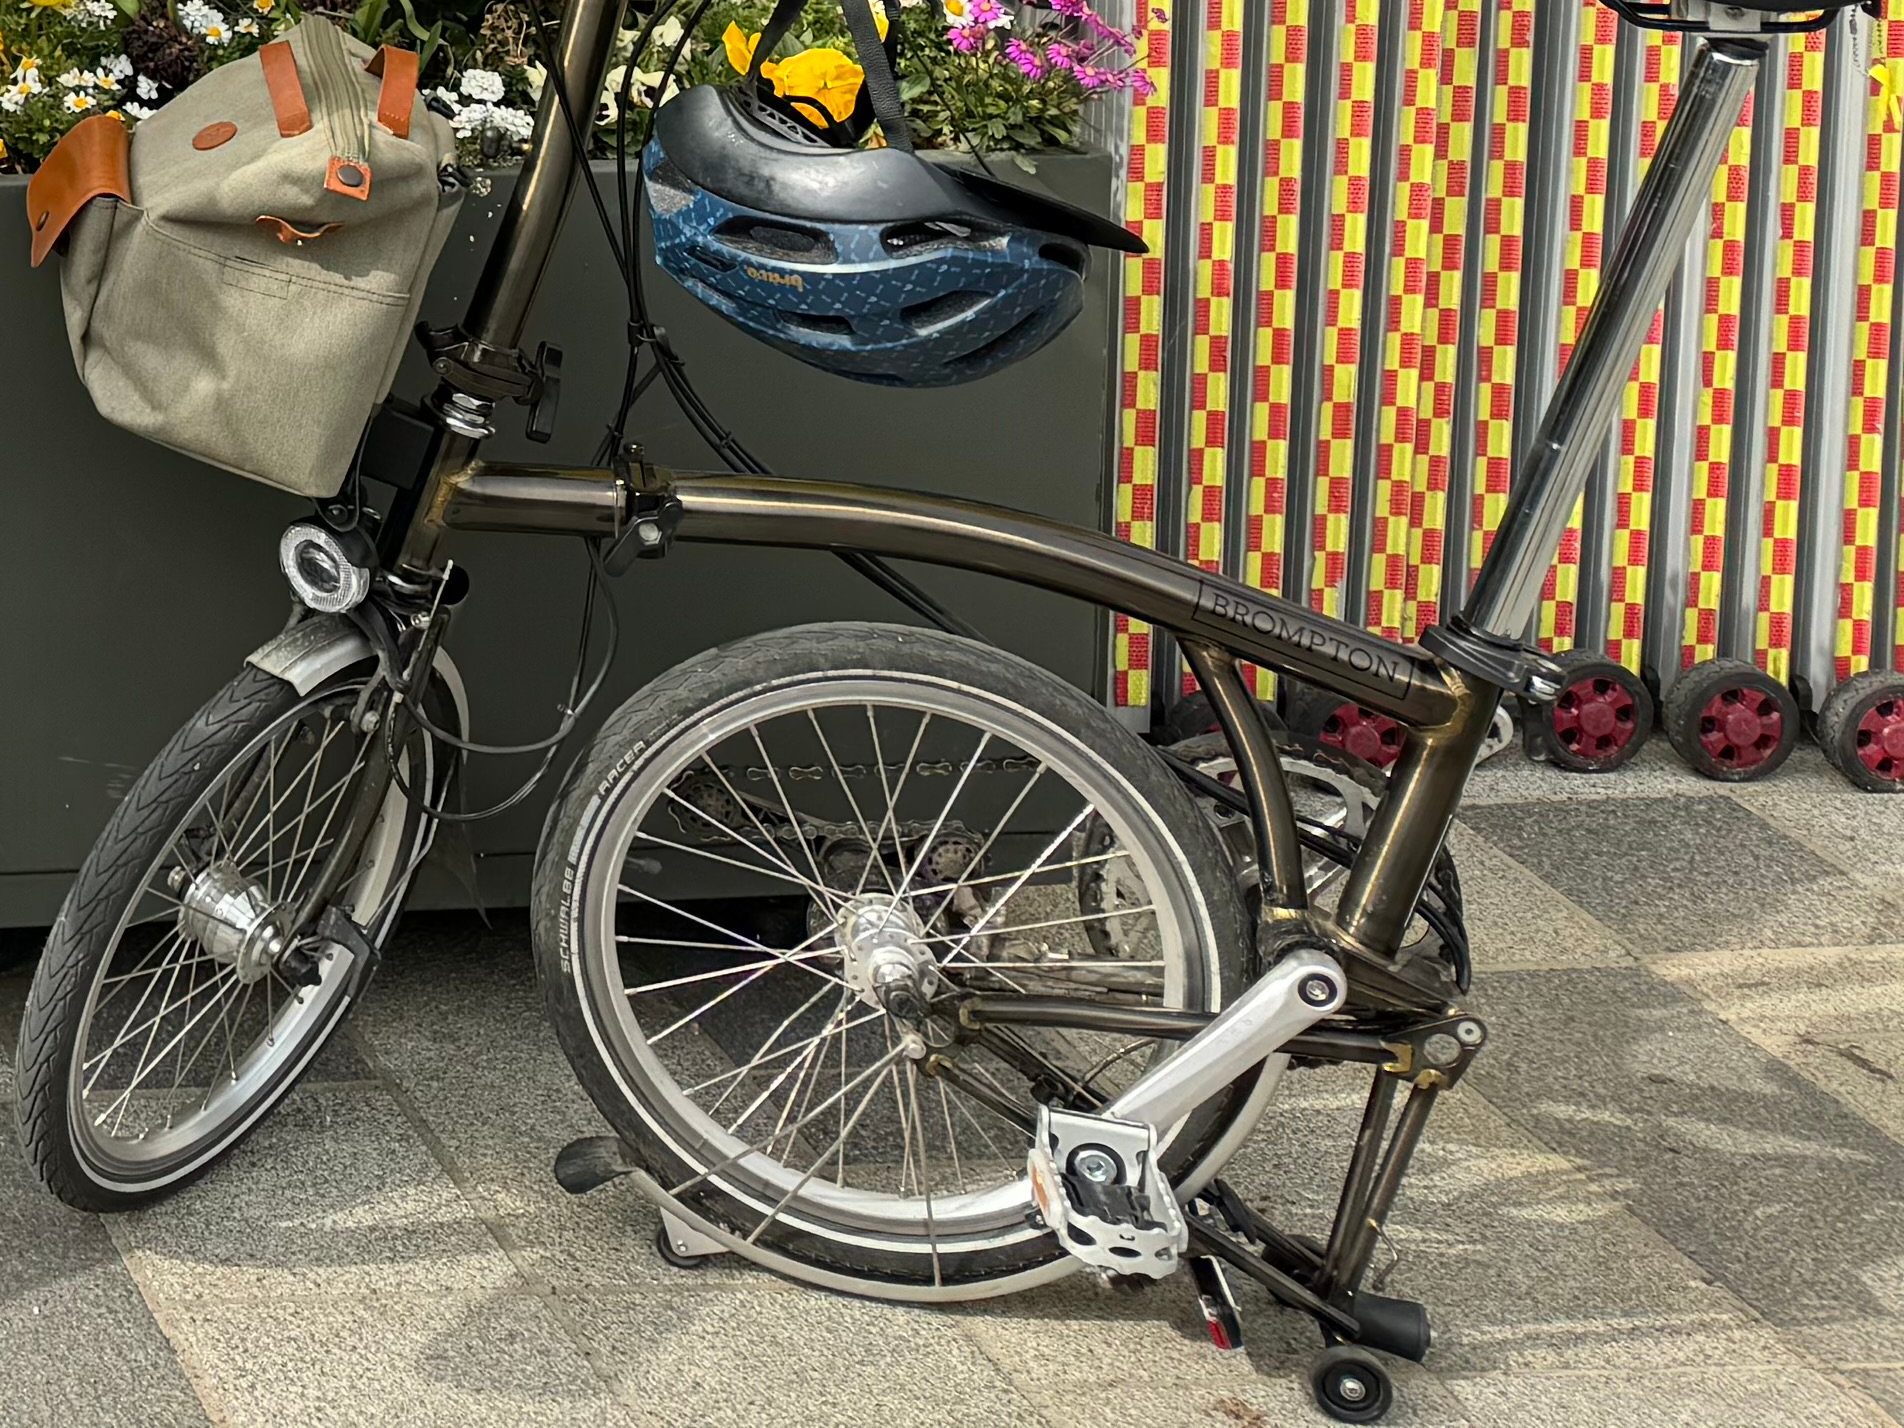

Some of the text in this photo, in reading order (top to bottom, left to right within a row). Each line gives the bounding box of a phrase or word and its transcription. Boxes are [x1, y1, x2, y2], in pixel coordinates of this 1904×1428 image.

[1211, 592, 1400, 683] BROMPTON
[598, 739, 647, 796] RACER
[559, 866, 575, 975] SCHWALBE
